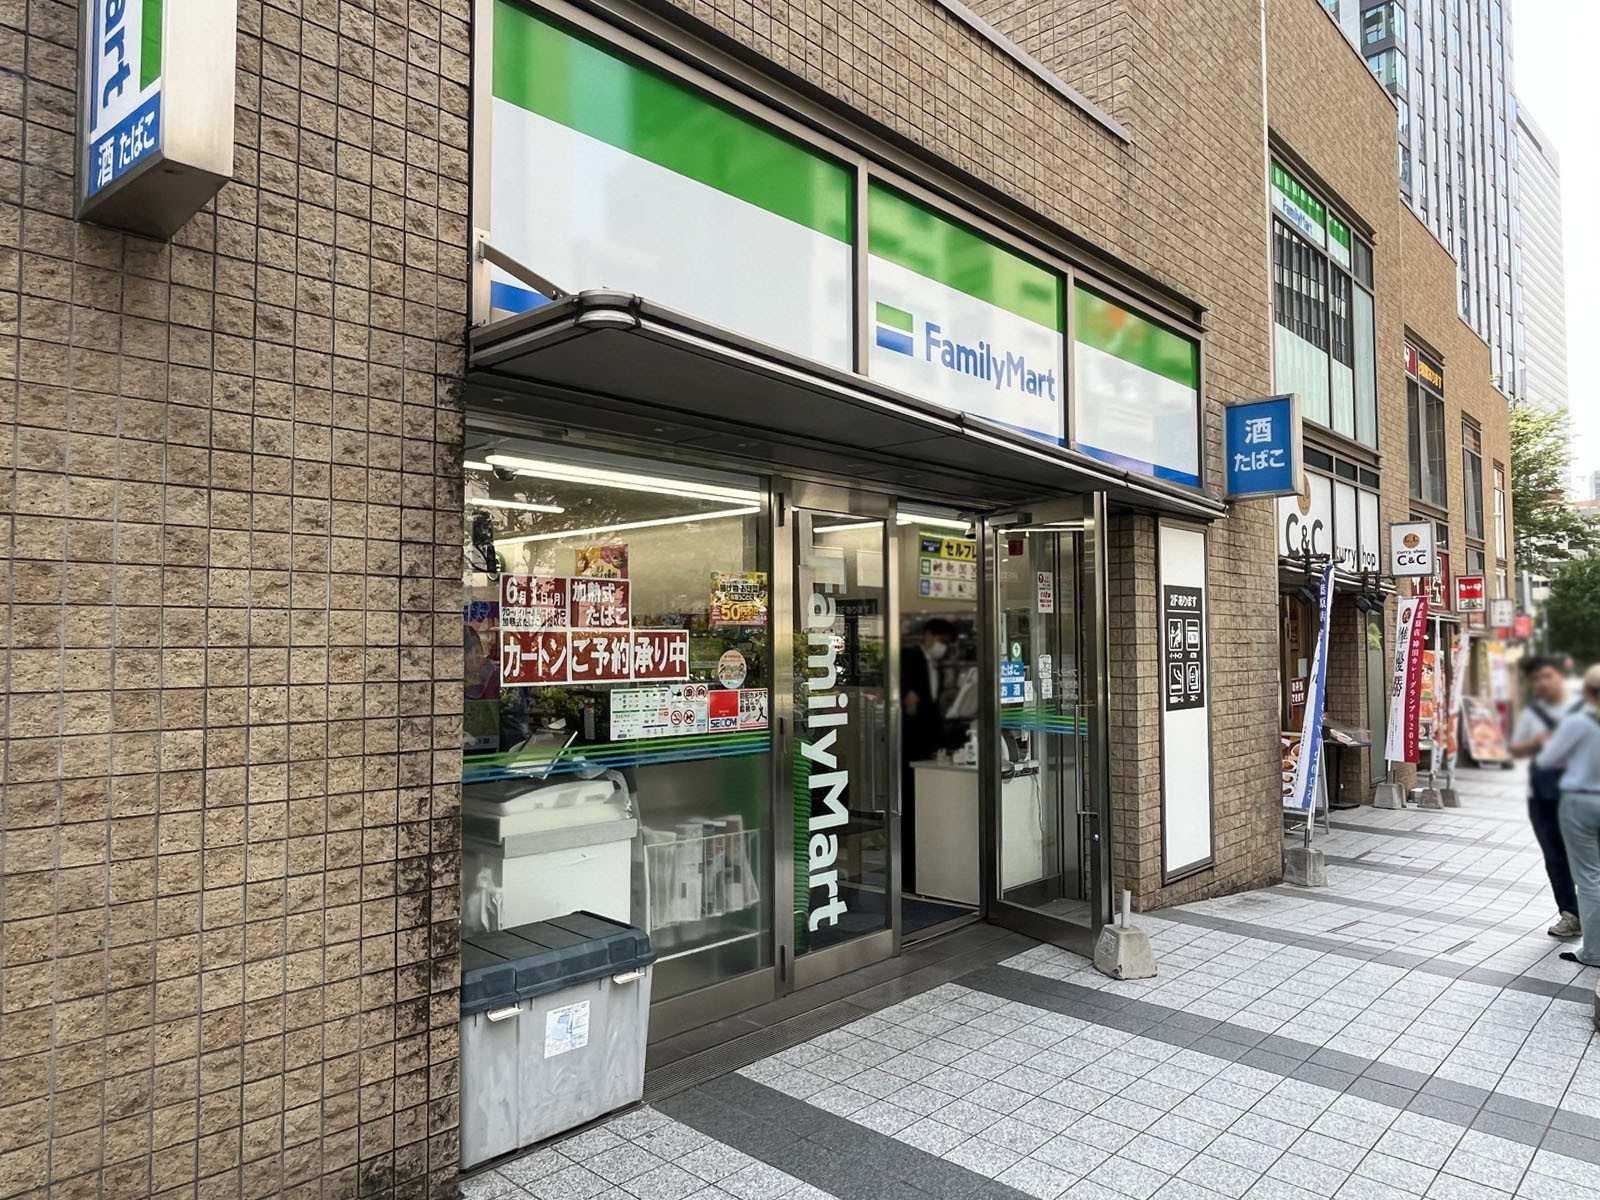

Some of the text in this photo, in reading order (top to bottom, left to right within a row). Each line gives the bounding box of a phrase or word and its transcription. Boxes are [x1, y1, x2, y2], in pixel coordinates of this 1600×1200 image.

[97, 111, 155, 188] 酒 たばこ
[925, 321, 1056, 402] FamilyMart
[1244, 417, 1272, 445] 酒
[1233, 449, 1286, 472] たばこ
[1397, 554, 1427, 566] C&C
[572, 580, 616, 604] 加熱式
[585, 605, 629, 626] たばこ
[503, 635, 687, 677] カートンご予約承り中
[1001, 664, 1020, 676] たばこ
[710, 718, 738, 729] SECOM
[801, 557, 849, 932] FamilyMart
